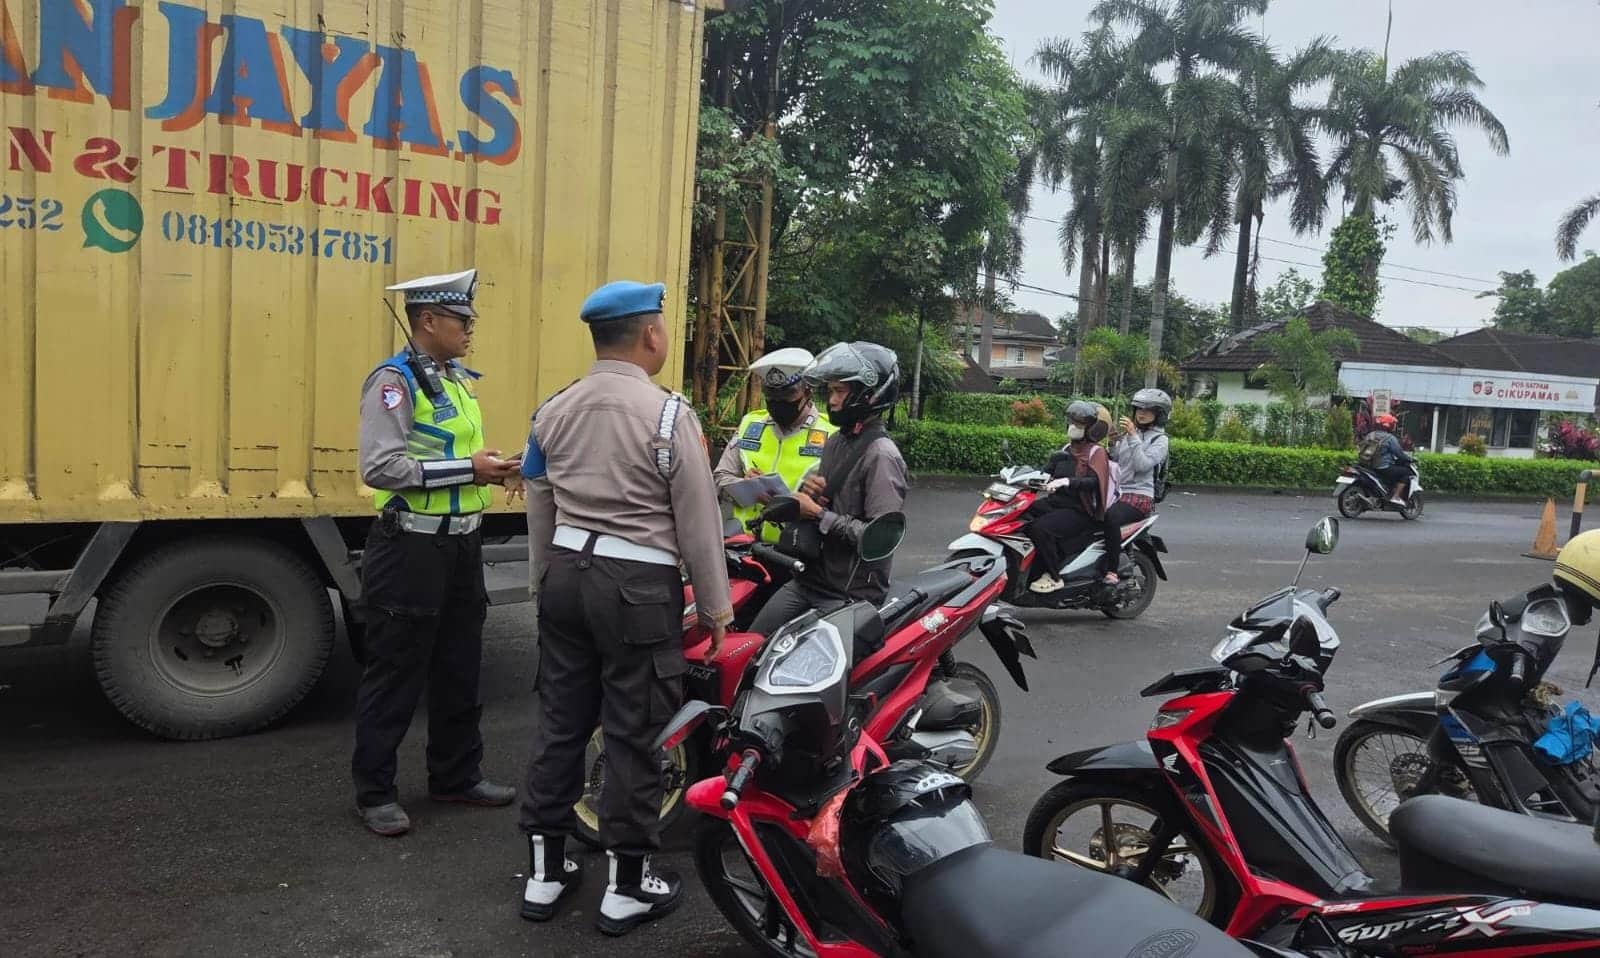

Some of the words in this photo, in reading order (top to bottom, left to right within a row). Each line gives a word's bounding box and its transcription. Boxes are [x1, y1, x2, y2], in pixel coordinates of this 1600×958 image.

[8, 126, 56, 173] N
[74, 137, 139, 183] &
[152, 145, 502, 225] TRUCKING
[163, 210, 393, 264] 081395317851
[1497, 389, 1560, 401] CIKUPAMAS
